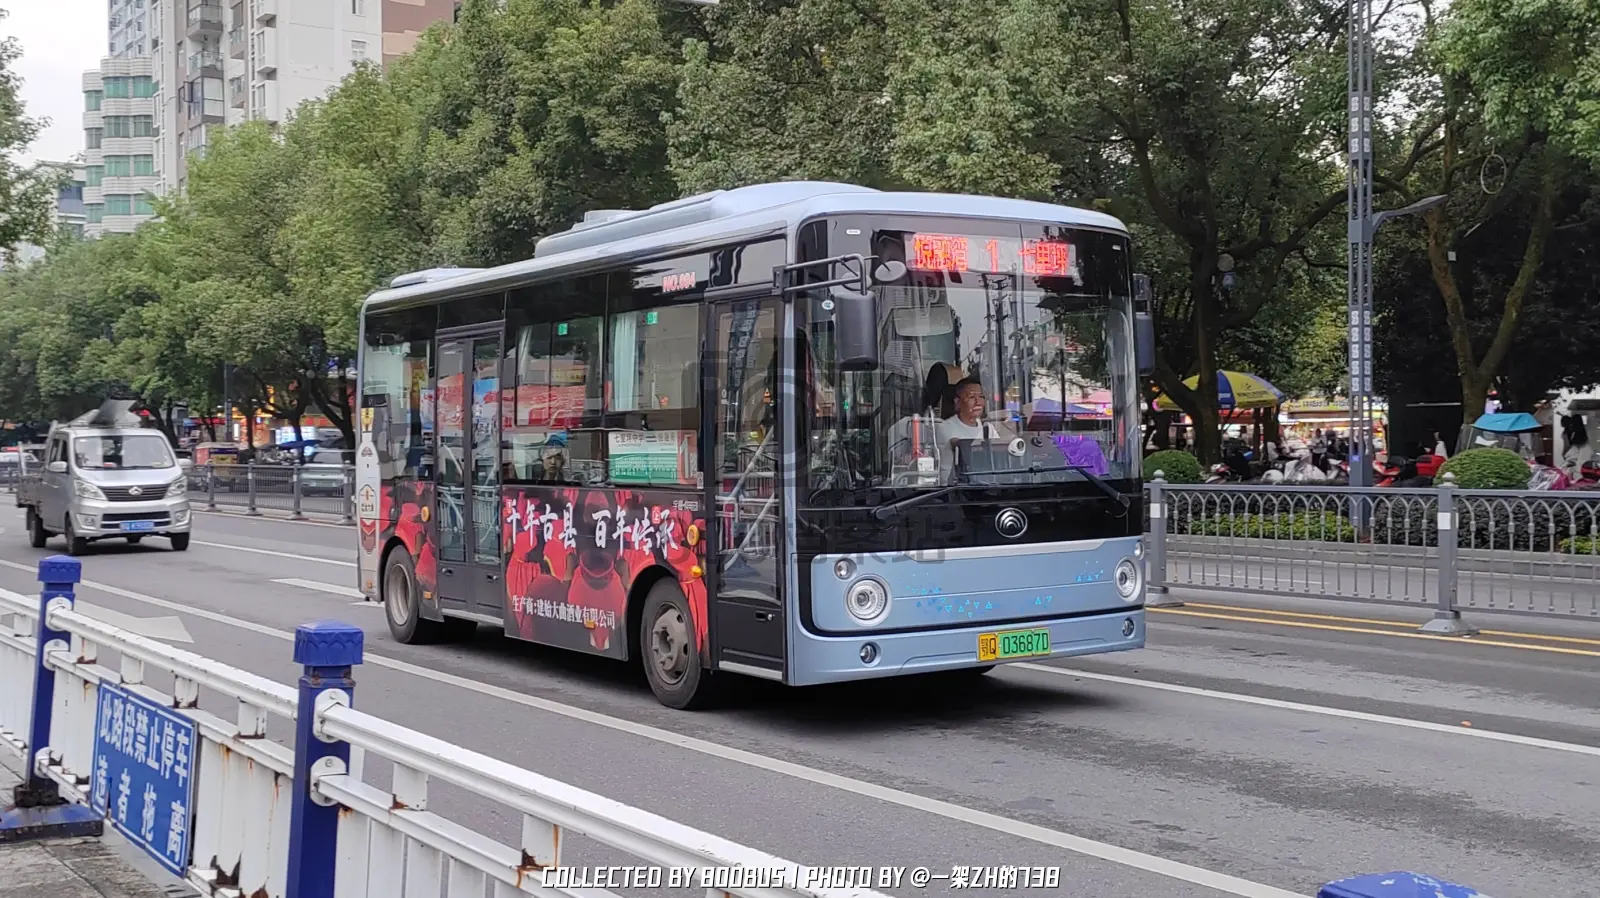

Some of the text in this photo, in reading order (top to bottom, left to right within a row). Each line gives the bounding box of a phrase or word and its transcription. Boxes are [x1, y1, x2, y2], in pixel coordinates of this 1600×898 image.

[986, 239, 998, 272] 1
[1019, 240, 1069, 275] 七里坪
[507, 498, 678, 559] 千年古县 百年传承
[1003, 633, 1049, 654] 03687D
[100, 693, 189, 788] 此路段禁止停车
